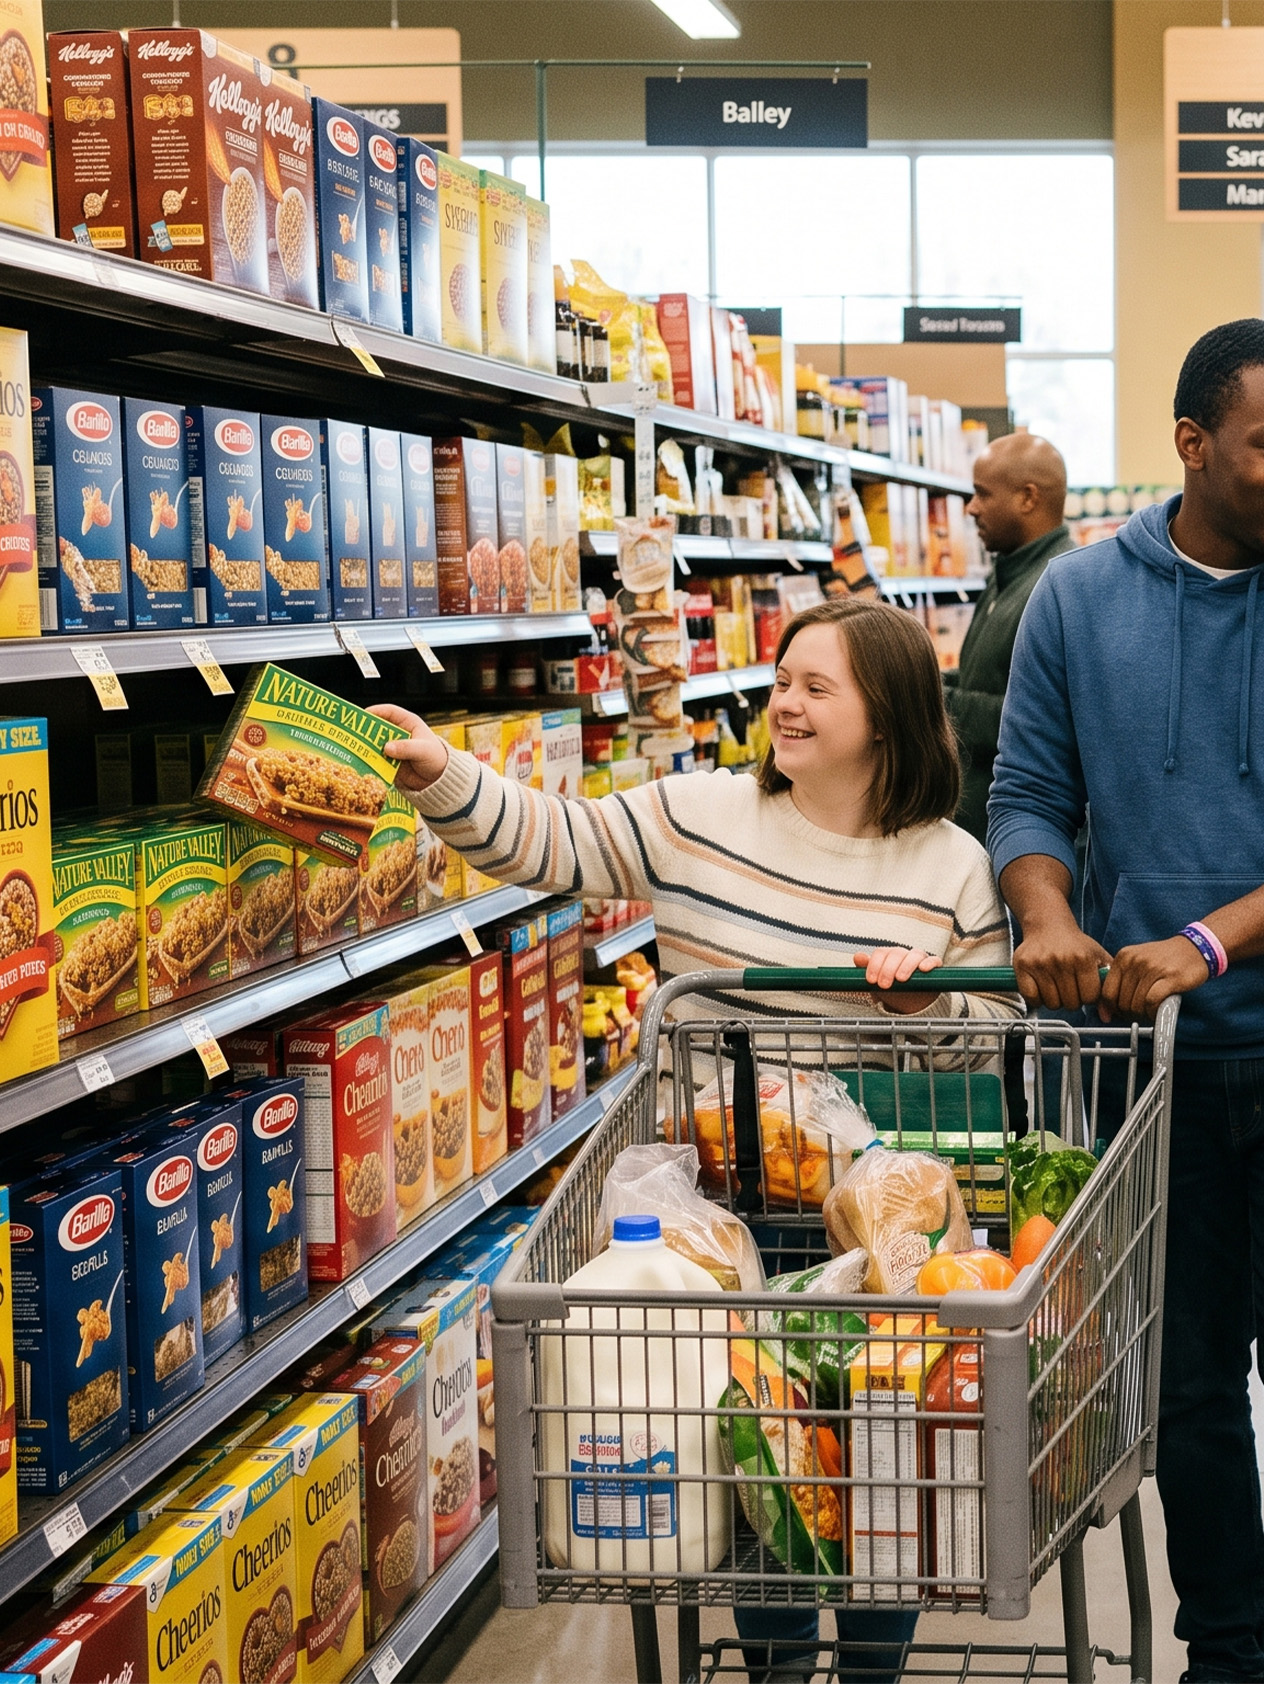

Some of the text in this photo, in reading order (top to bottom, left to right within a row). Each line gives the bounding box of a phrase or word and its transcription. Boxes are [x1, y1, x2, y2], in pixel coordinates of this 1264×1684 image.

[722, 101, 792, 129] Balley
[262, 672, 340, 719] NATURE
[52, 861, 93, 900] NATURE
[93, 851, 131, 886] VALLEY
[148, 839, 187, 881] NATURE
[187, 832, 222, 864] VALLEY
[305, 1457, 358, 1527] Cheerios
[232, 1516, 292, 1593] Cheerios
[156, 1584, 222, 1672] Cheerios
